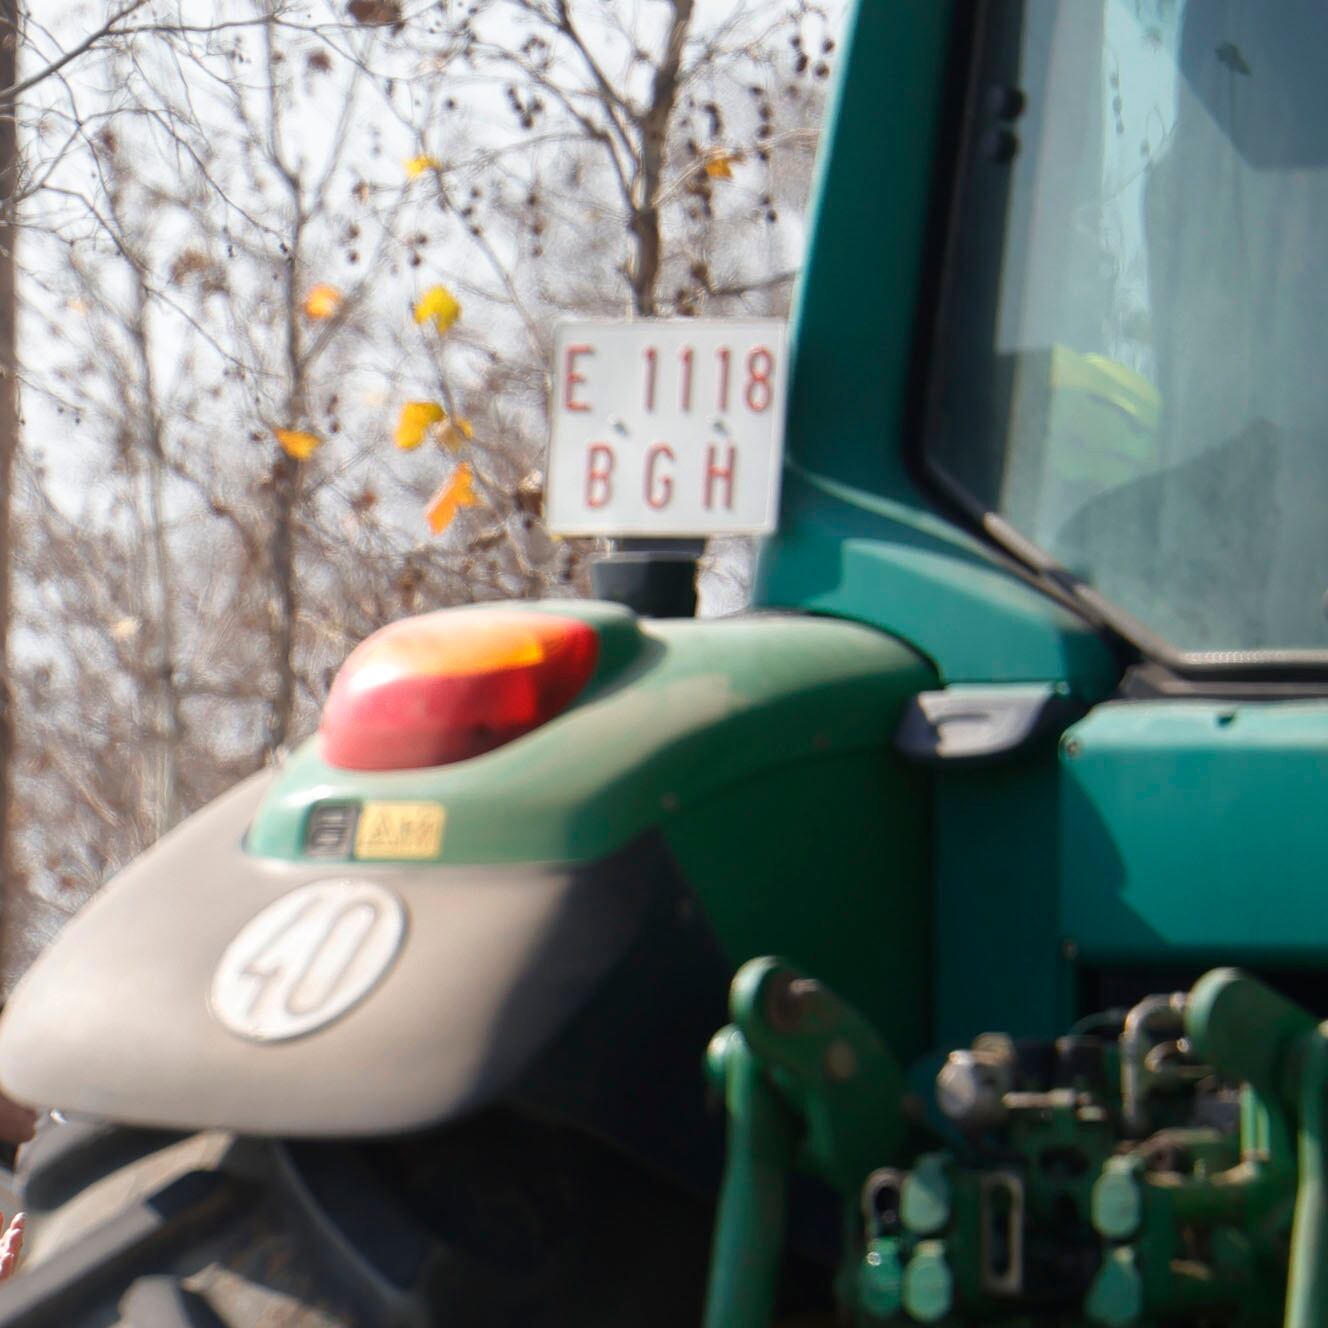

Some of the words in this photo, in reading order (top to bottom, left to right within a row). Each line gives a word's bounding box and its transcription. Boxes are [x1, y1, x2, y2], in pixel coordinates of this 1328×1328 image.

[563, 343, 597, 413] E
[643, 345, 776, 415] 1118
[239, 893, 380, 1019] 40
